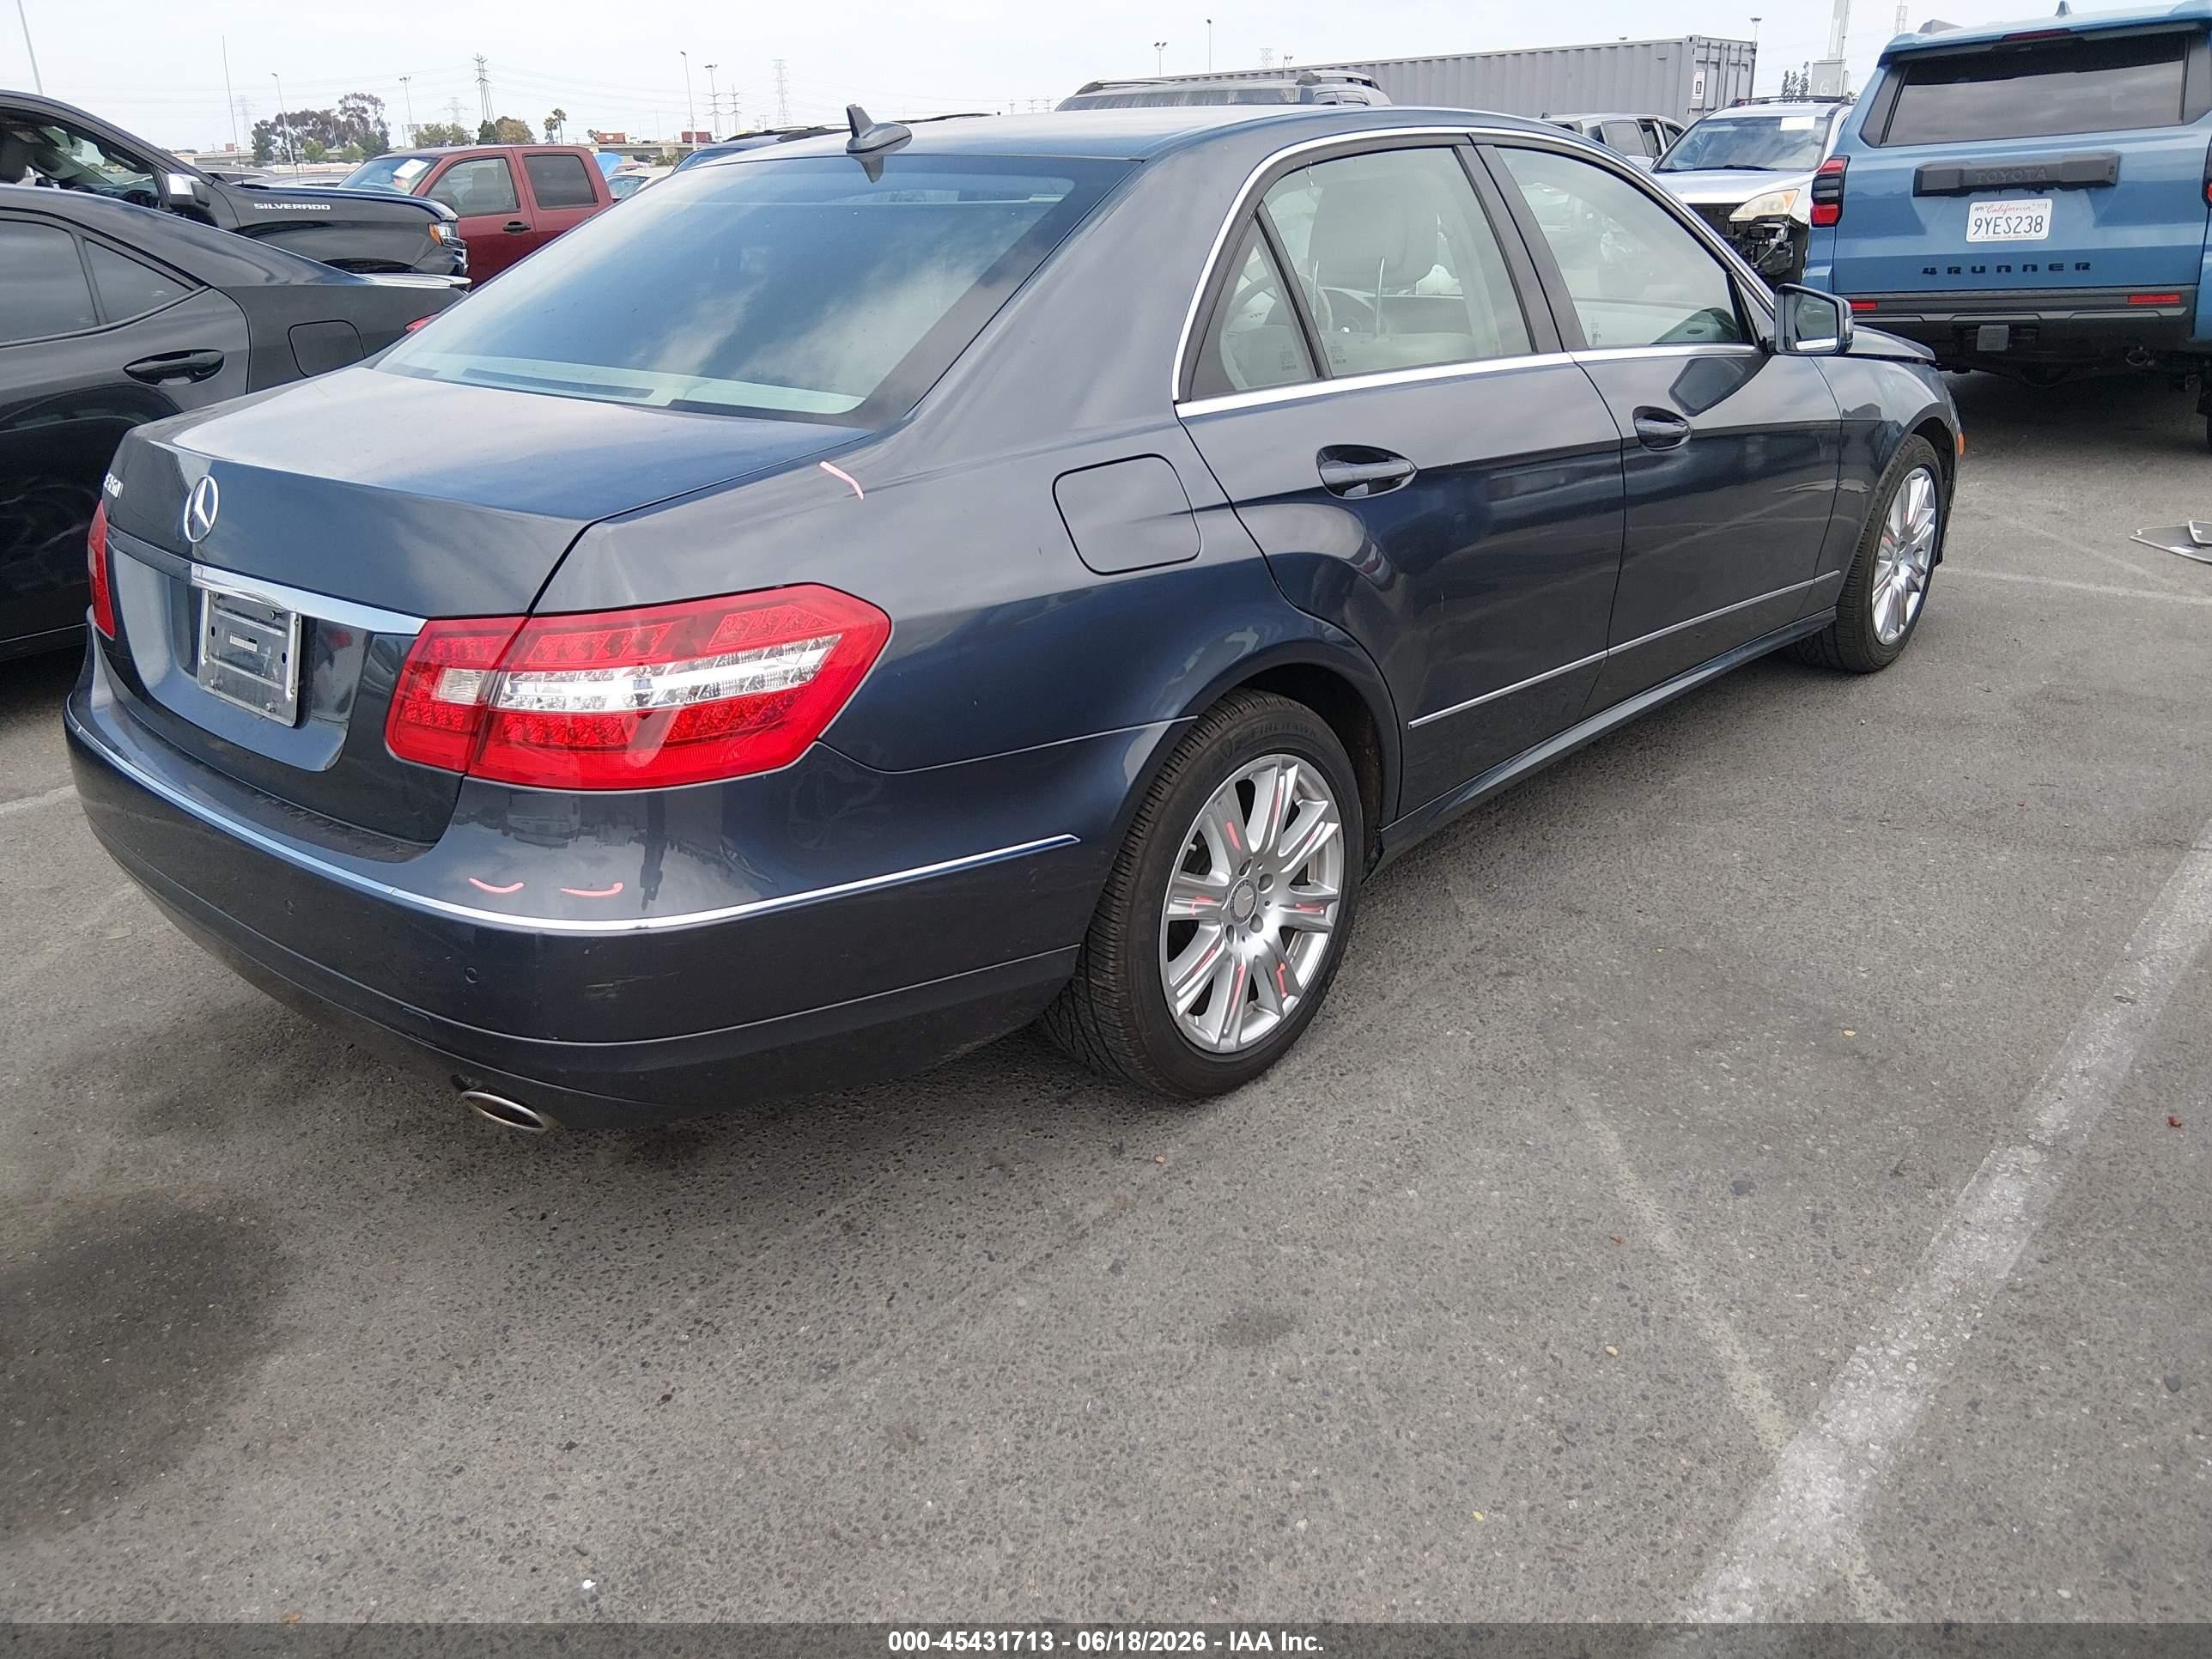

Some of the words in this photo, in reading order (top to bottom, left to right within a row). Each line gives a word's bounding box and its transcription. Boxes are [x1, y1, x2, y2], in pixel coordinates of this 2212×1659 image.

[1977, 167, 2047, 183] TOYOTA
[1972, 215, 2044, 235] 9YES238
[1922, 261, 2092, 275] 4RUNNER
